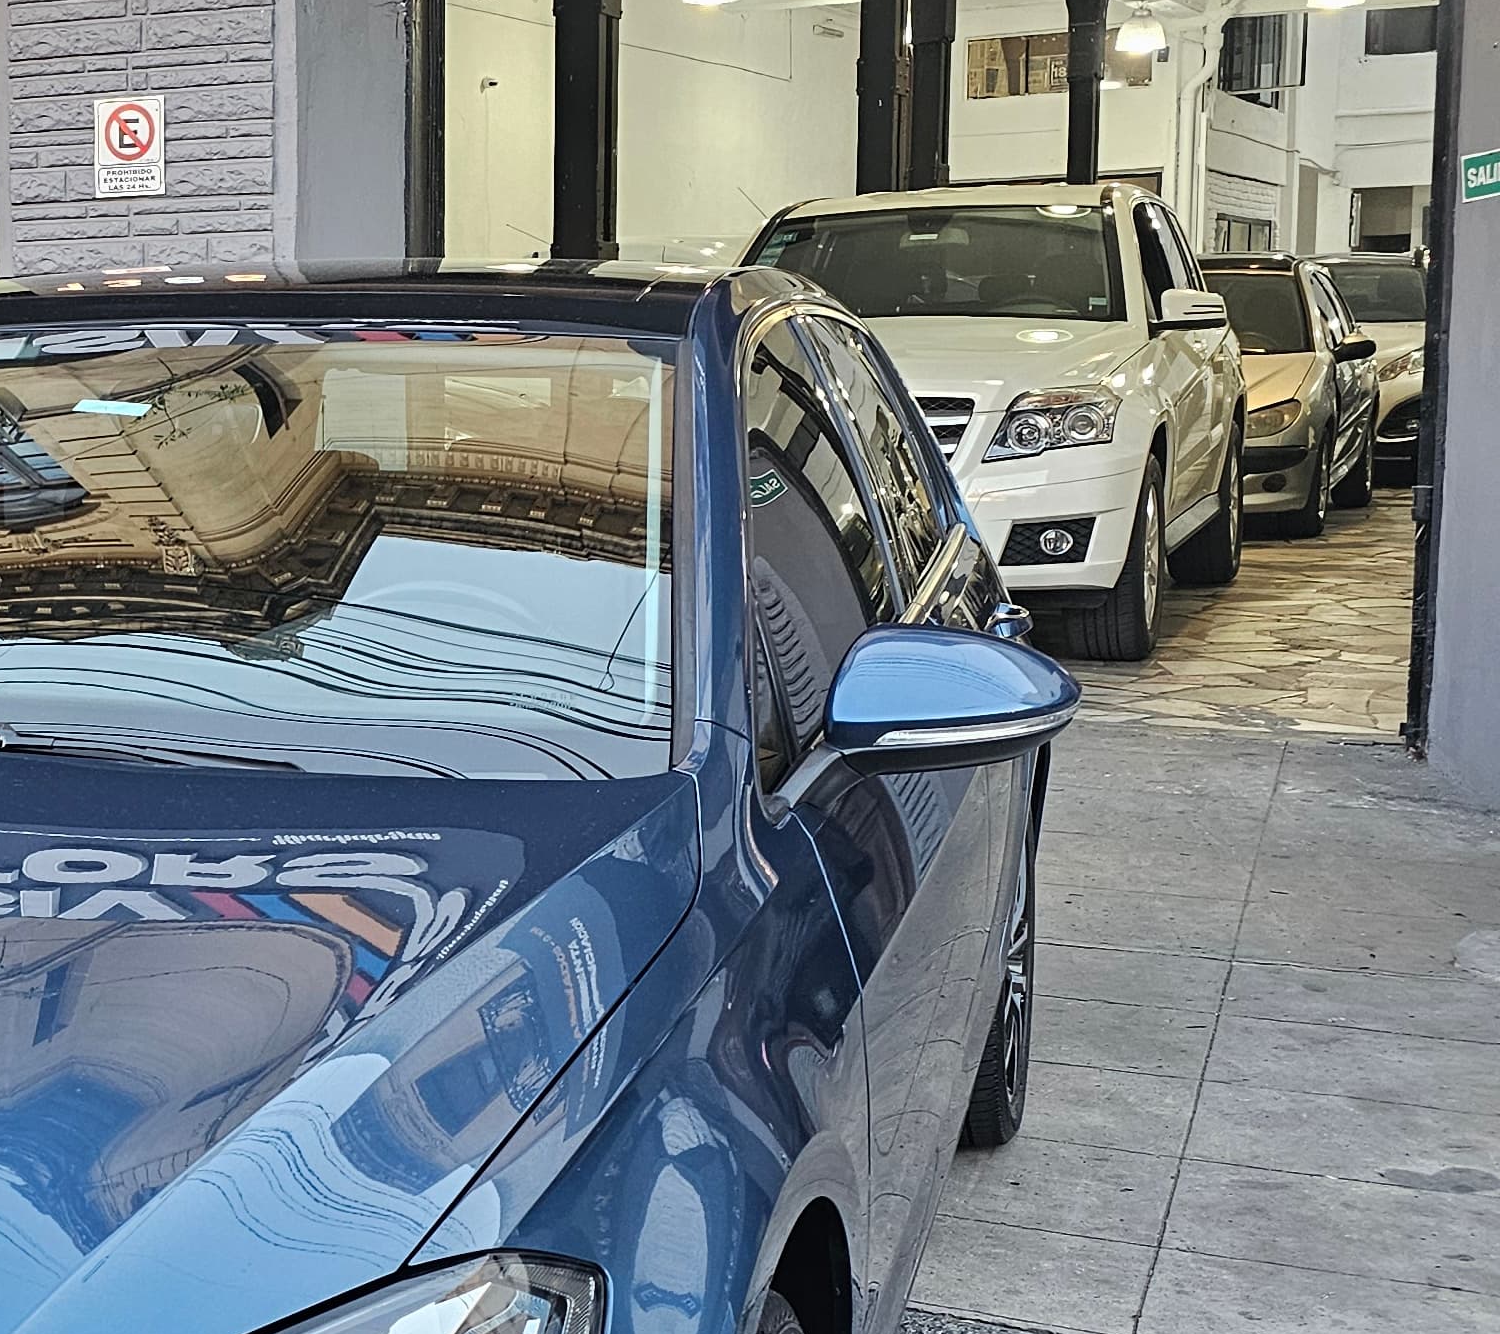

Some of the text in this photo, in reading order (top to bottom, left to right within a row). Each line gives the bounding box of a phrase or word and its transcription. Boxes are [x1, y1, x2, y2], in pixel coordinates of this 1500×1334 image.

[106, 168, 153, 176] PROHIBIDO
[1467, 162, 1500, 188] SALI
[103, 175, 156, 184] ESTACIONAR
